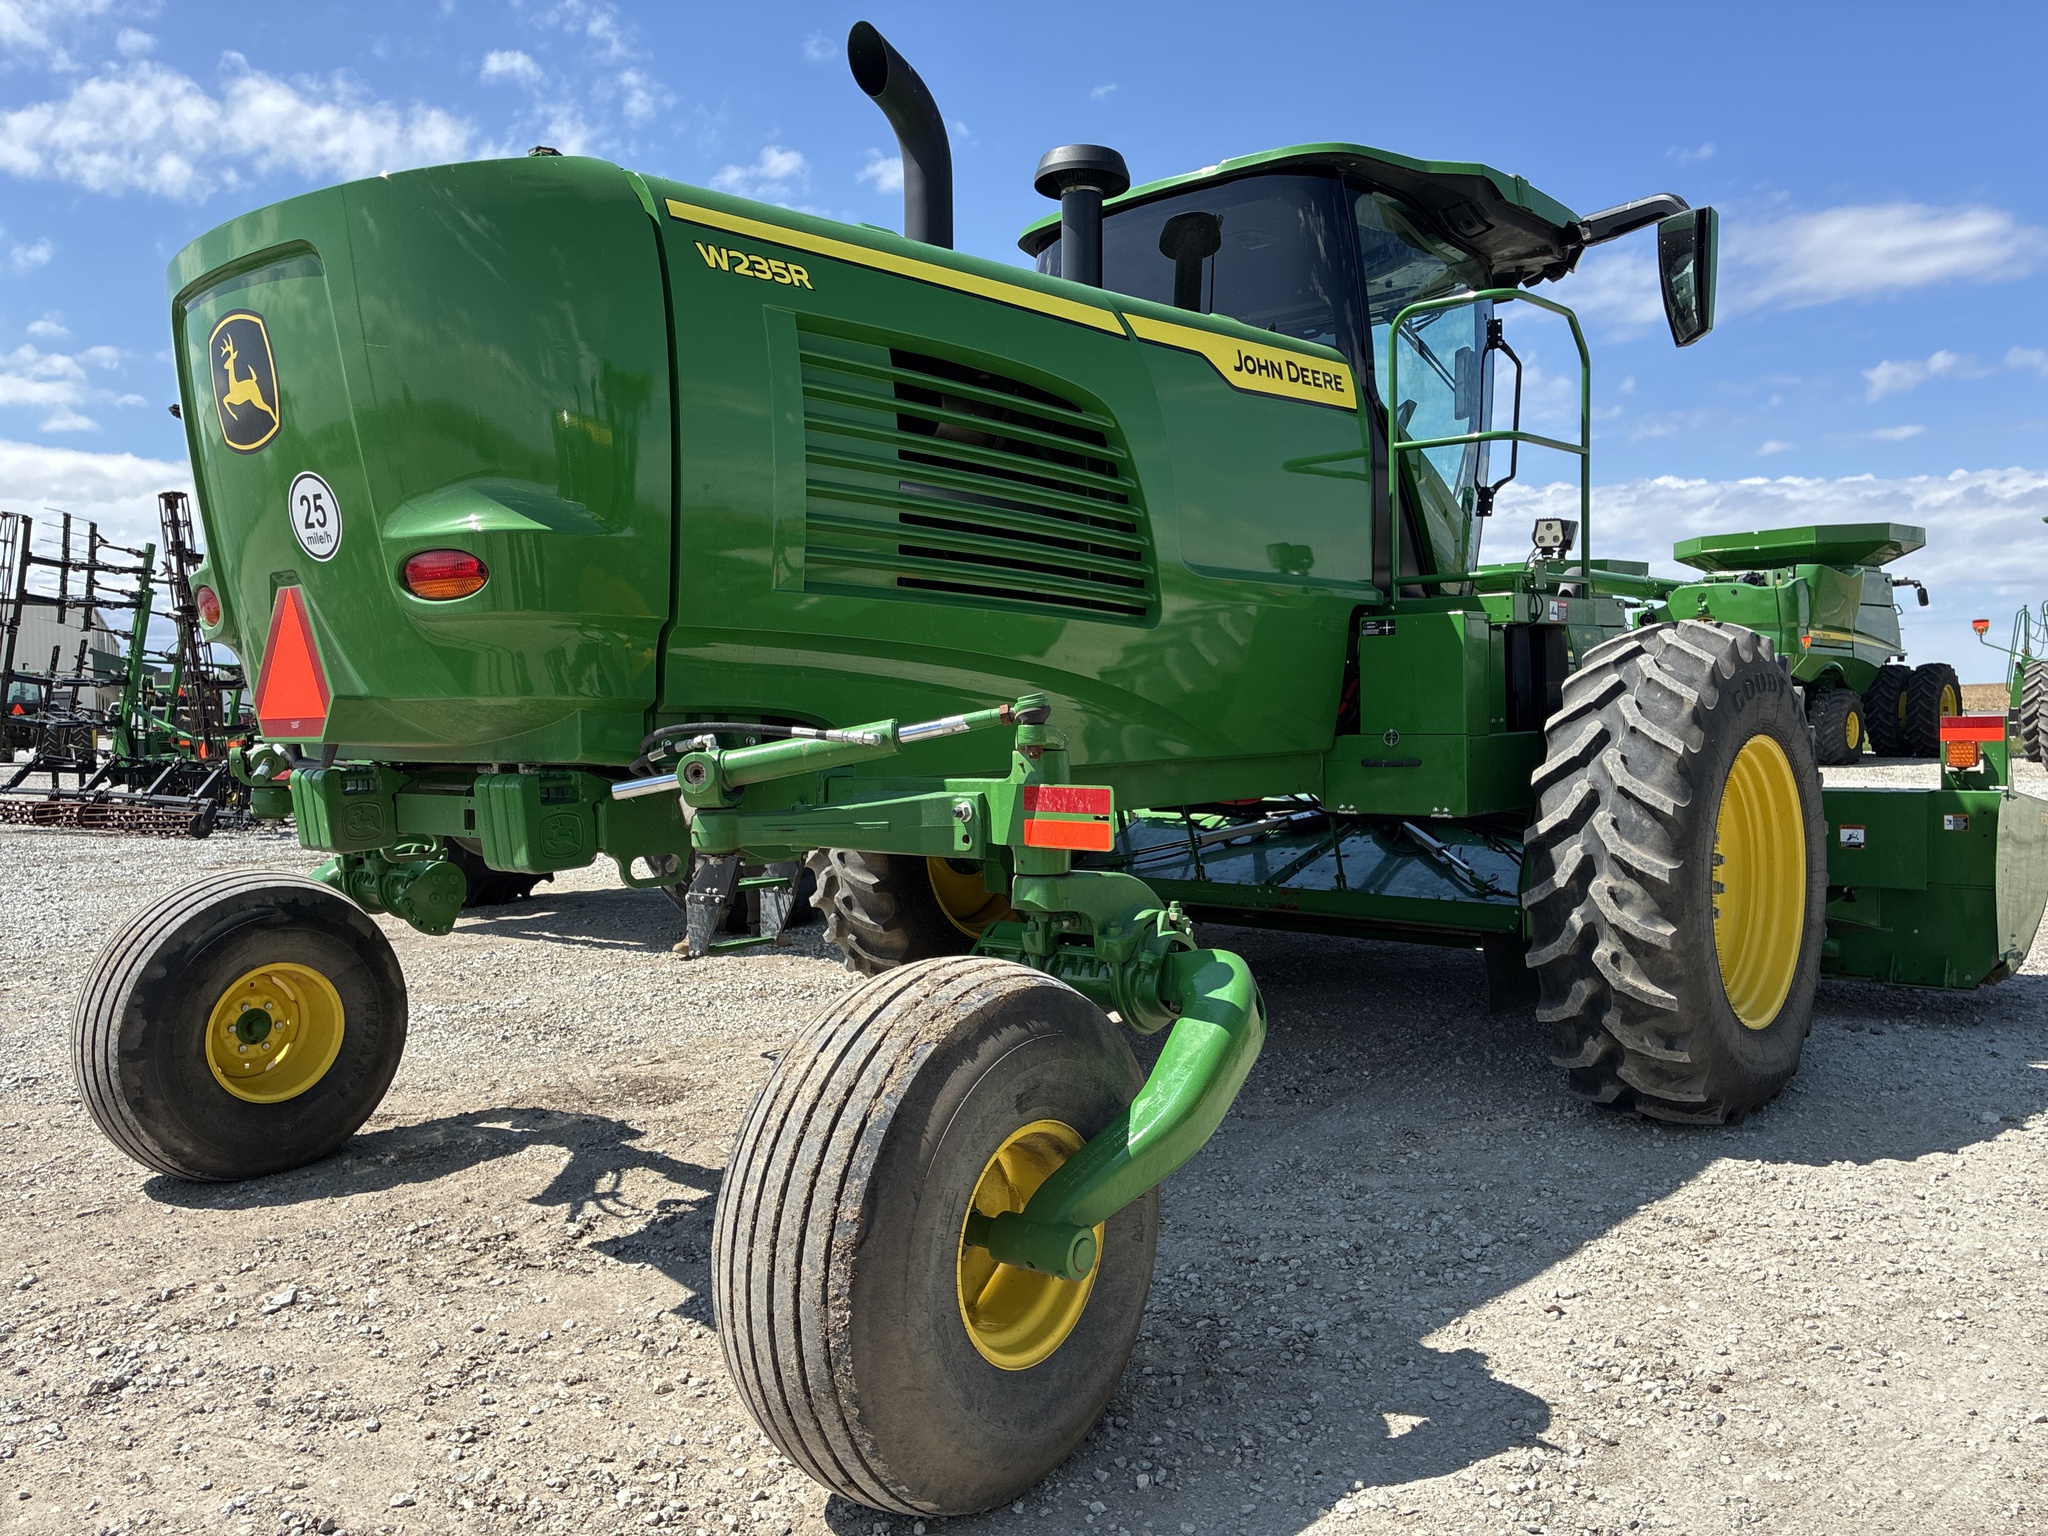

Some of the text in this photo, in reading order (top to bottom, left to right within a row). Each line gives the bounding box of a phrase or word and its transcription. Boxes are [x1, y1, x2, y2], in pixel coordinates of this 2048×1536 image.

[693, 240, 816, 291] W235R
[1233, 349, 1345, 393] JOHN DEERE
[299, 493, 328, 530] 25
[306, 531, 333, 546] mile/h
